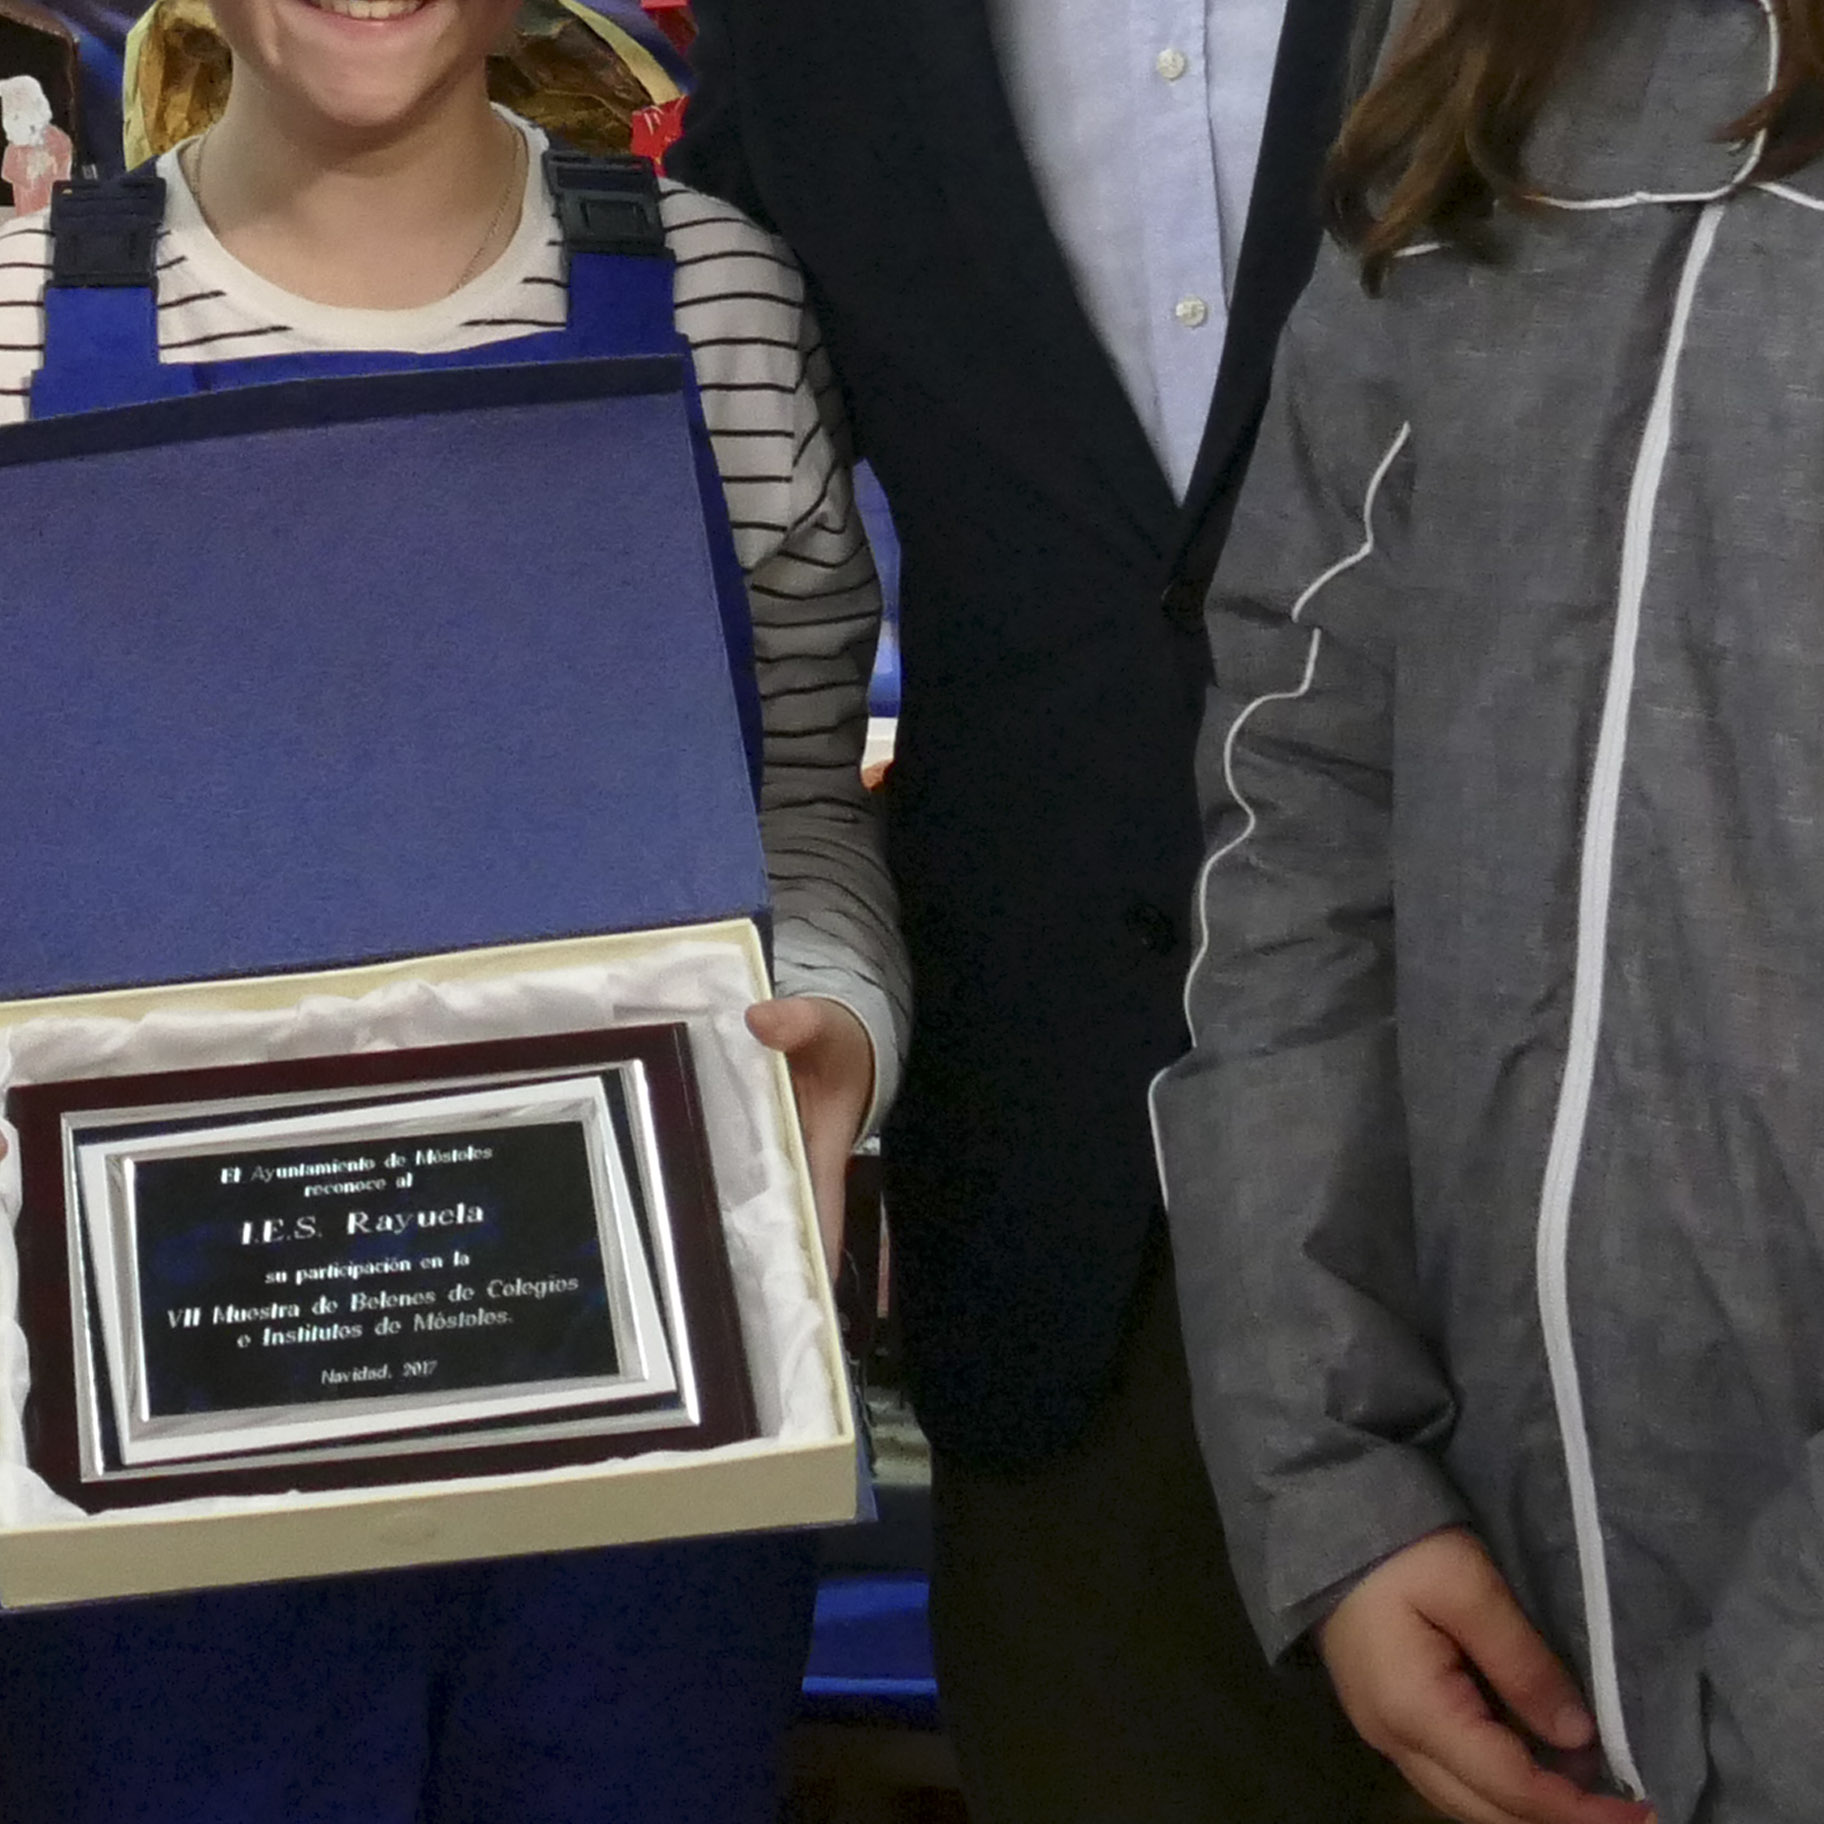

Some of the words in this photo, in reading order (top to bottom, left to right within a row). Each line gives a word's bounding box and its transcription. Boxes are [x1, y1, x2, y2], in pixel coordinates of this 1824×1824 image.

[219, 1166, 242, 1184] El
[250, 1155, 376, 1182] Ayuntamiento
[383, 1151, 407, 1169] de
[414, 1144, 494, 1167] Móstoles
[303, 1176, 387, 1198] reconoce
[395, 1172, 414, 1189] al
[241, 1215, 323, 1246] I.E.S.
[346, 1201, 485, 1236] Rayuela
[264, 1270, 288, 1284] su
[294, 1256, 412, 1286] participación
[419, 1256, 444, 1270] en
[452, 1249, 471, 1267] la
[167, 1306, 202, 1329] VII
[212, 1301, 301, 1326] Muestra
[310, 1294, 339, 1316] de
[349, 1289, 437, 1313] Belenes
[447, 1282, 476, 1303] de
[486, 1275, 580, 1299] Colegios
[236, 1334, 252, 1349] e
[261, 1322, 363, 1348] Institutos
[374, 1315, 402, 1336] de
[402, 1359, 439, 1377] 2017
